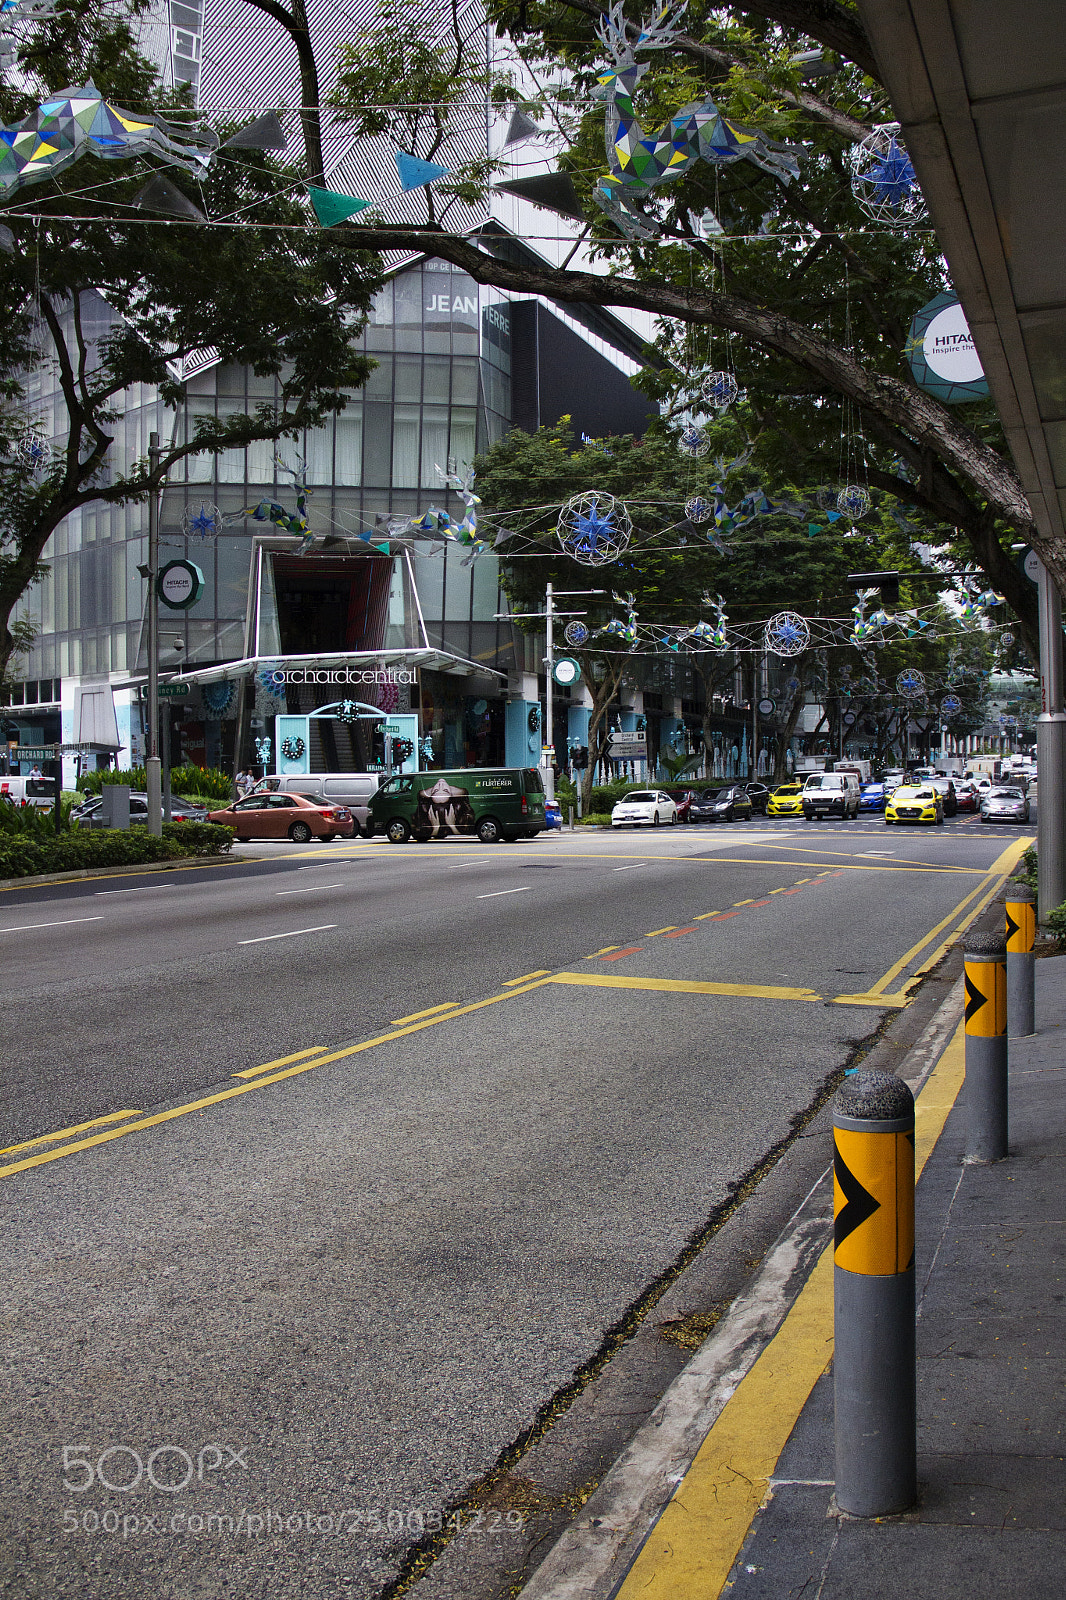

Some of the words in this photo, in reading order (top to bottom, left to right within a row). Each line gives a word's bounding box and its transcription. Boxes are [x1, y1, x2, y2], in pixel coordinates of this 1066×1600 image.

[426, 294, 478, 314] JEAN
[935, 333, 974, 346] HITAC
[932, 346, 960, 355] Inspire
[272, 666, 418, 684] orchardcentral
[17, 750, 44, 759] ORCHARD
